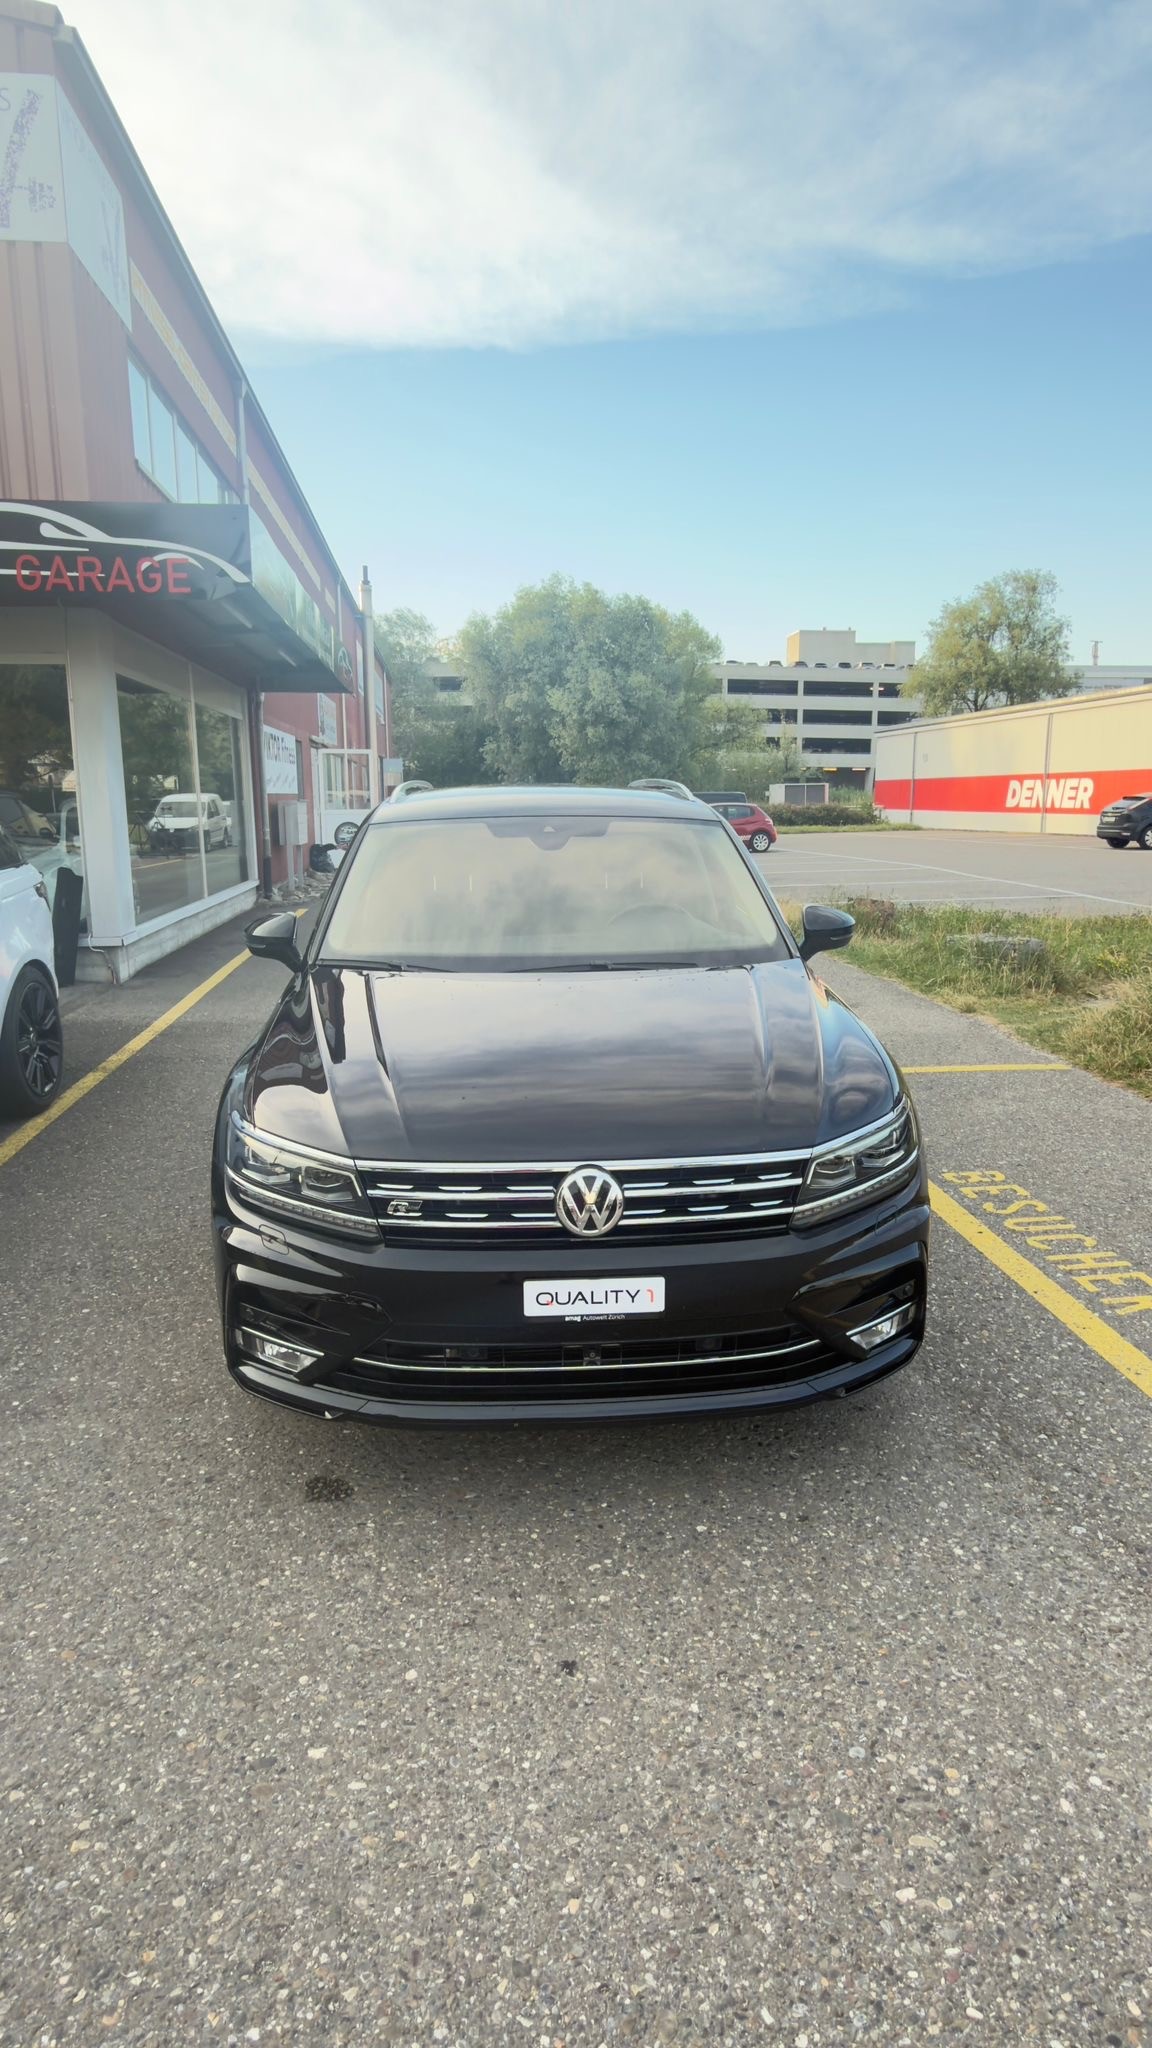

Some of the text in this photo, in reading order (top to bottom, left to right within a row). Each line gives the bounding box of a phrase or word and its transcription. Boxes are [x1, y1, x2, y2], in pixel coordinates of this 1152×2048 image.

[15, 554, 192, 593] GARAGE
[1005, 778, 1094, 809] DENNER
[535, 1288, 654, 1306] QUALITY 1
